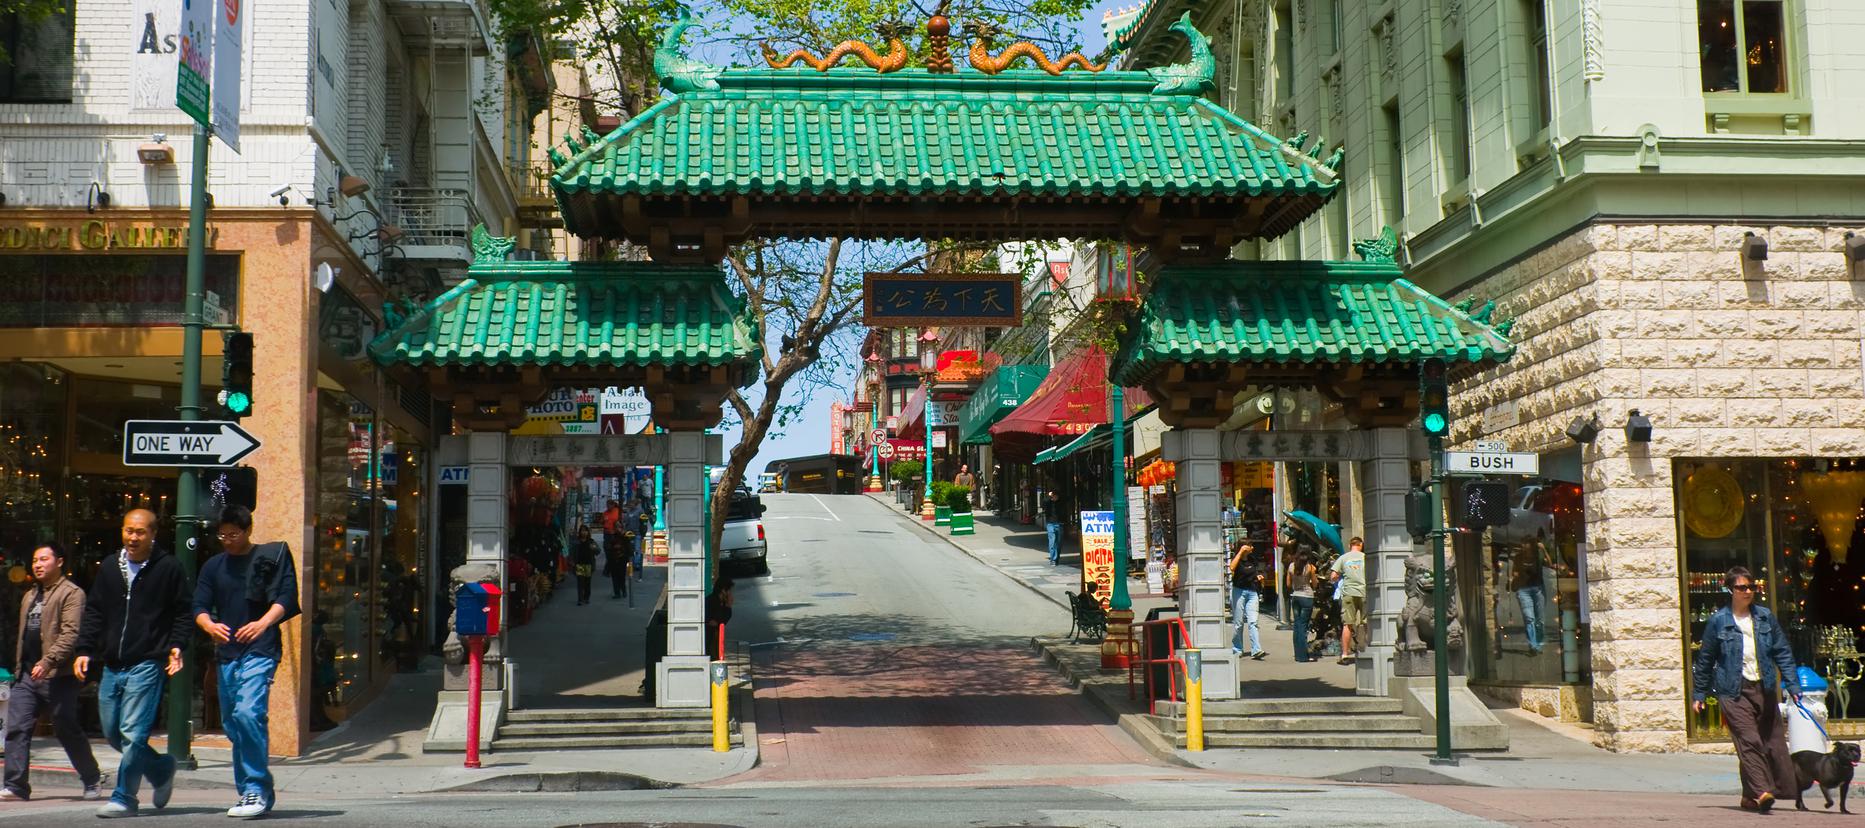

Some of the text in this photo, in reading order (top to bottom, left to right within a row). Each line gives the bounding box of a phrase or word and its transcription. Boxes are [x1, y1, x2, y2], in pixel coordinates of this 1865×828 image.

[607, 387, 643, 397] Aian
[530, 401, 574, 414] HOTO
[605, 399, 644, 411] Image
[136, 436, 215, 452] ONE WAY
[1487, 442, 1505, 451] 500
[1470, 456, 1514, 469] BUSH
[1085, 523, 1114, 533] ATM
[1085, 548, 1114, 565] DIGITA
